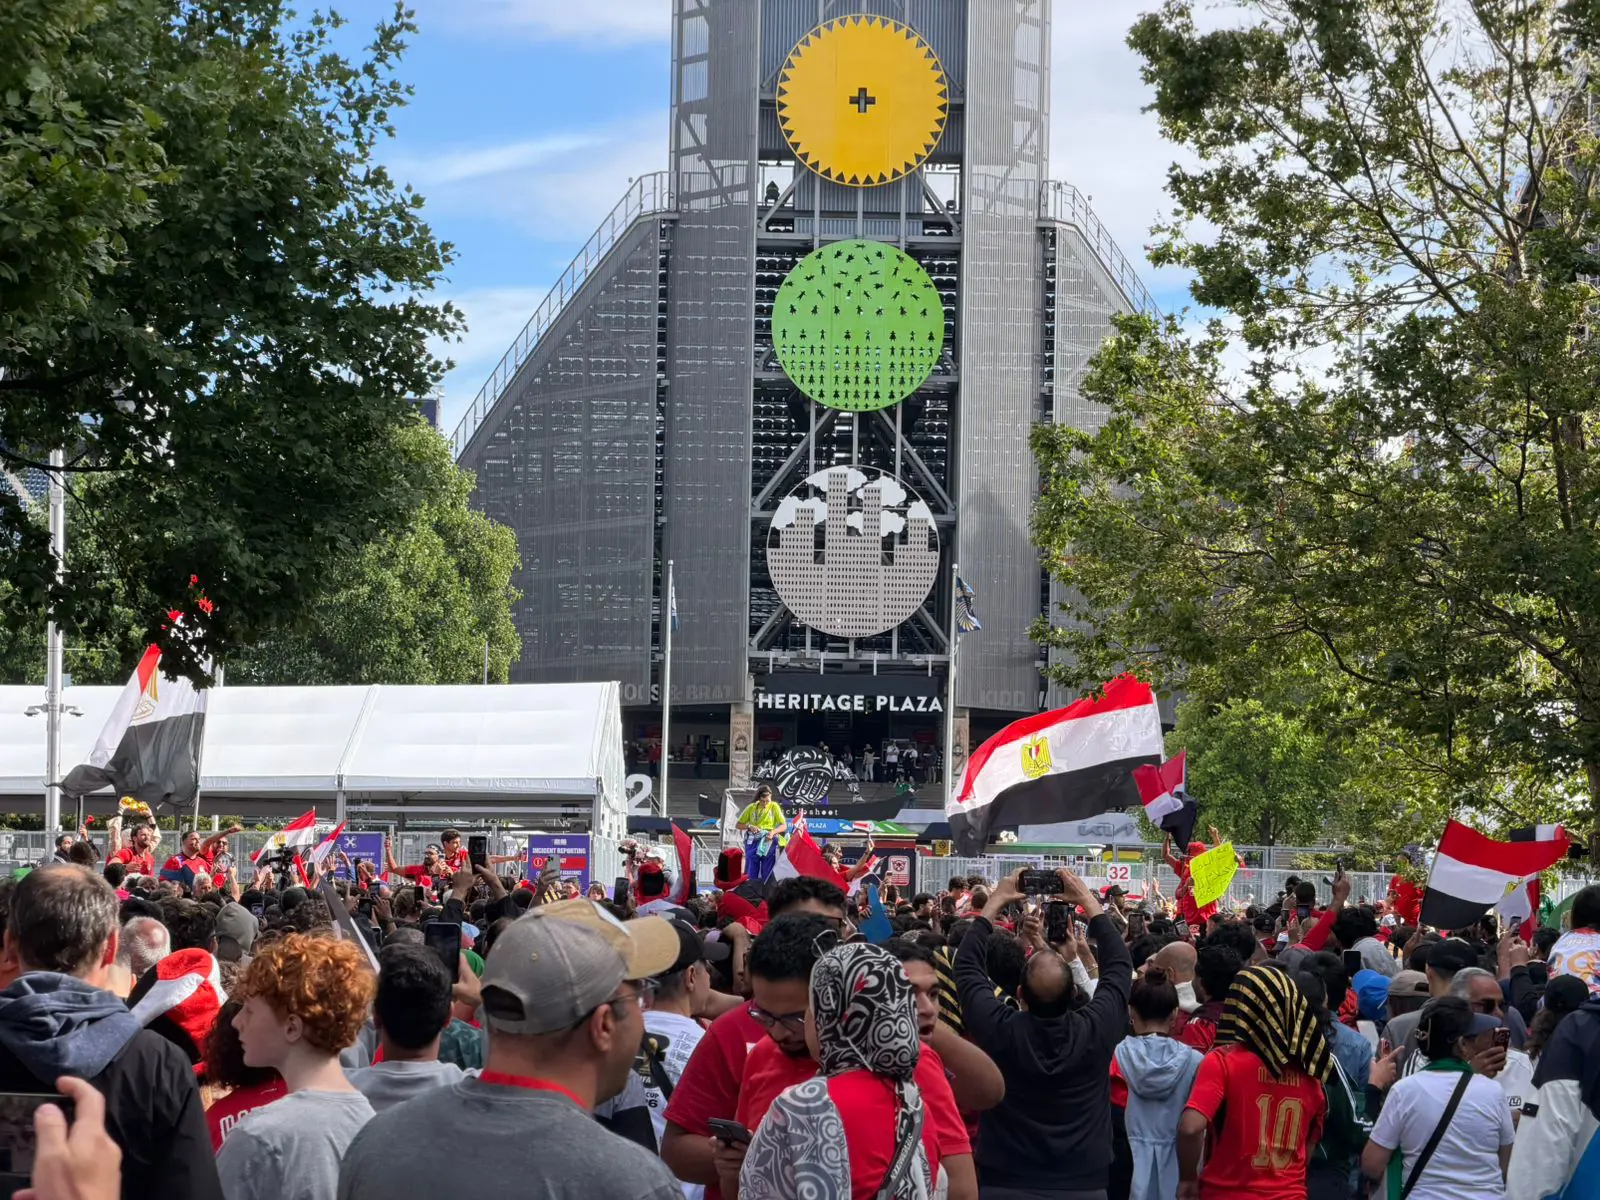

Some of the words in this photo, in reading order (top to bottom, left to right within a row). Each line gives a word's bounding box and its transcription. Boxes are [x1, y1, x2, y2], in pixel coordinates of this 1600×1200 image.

[757, 692, 865, 711] HERITAGE
[875, 695, 943, 712] PLAZA
[1109, 866, 1129, 880] 32
[645, 1091, 659, 1099] CUP
[1251, 1093, 1303, 1170] 10
